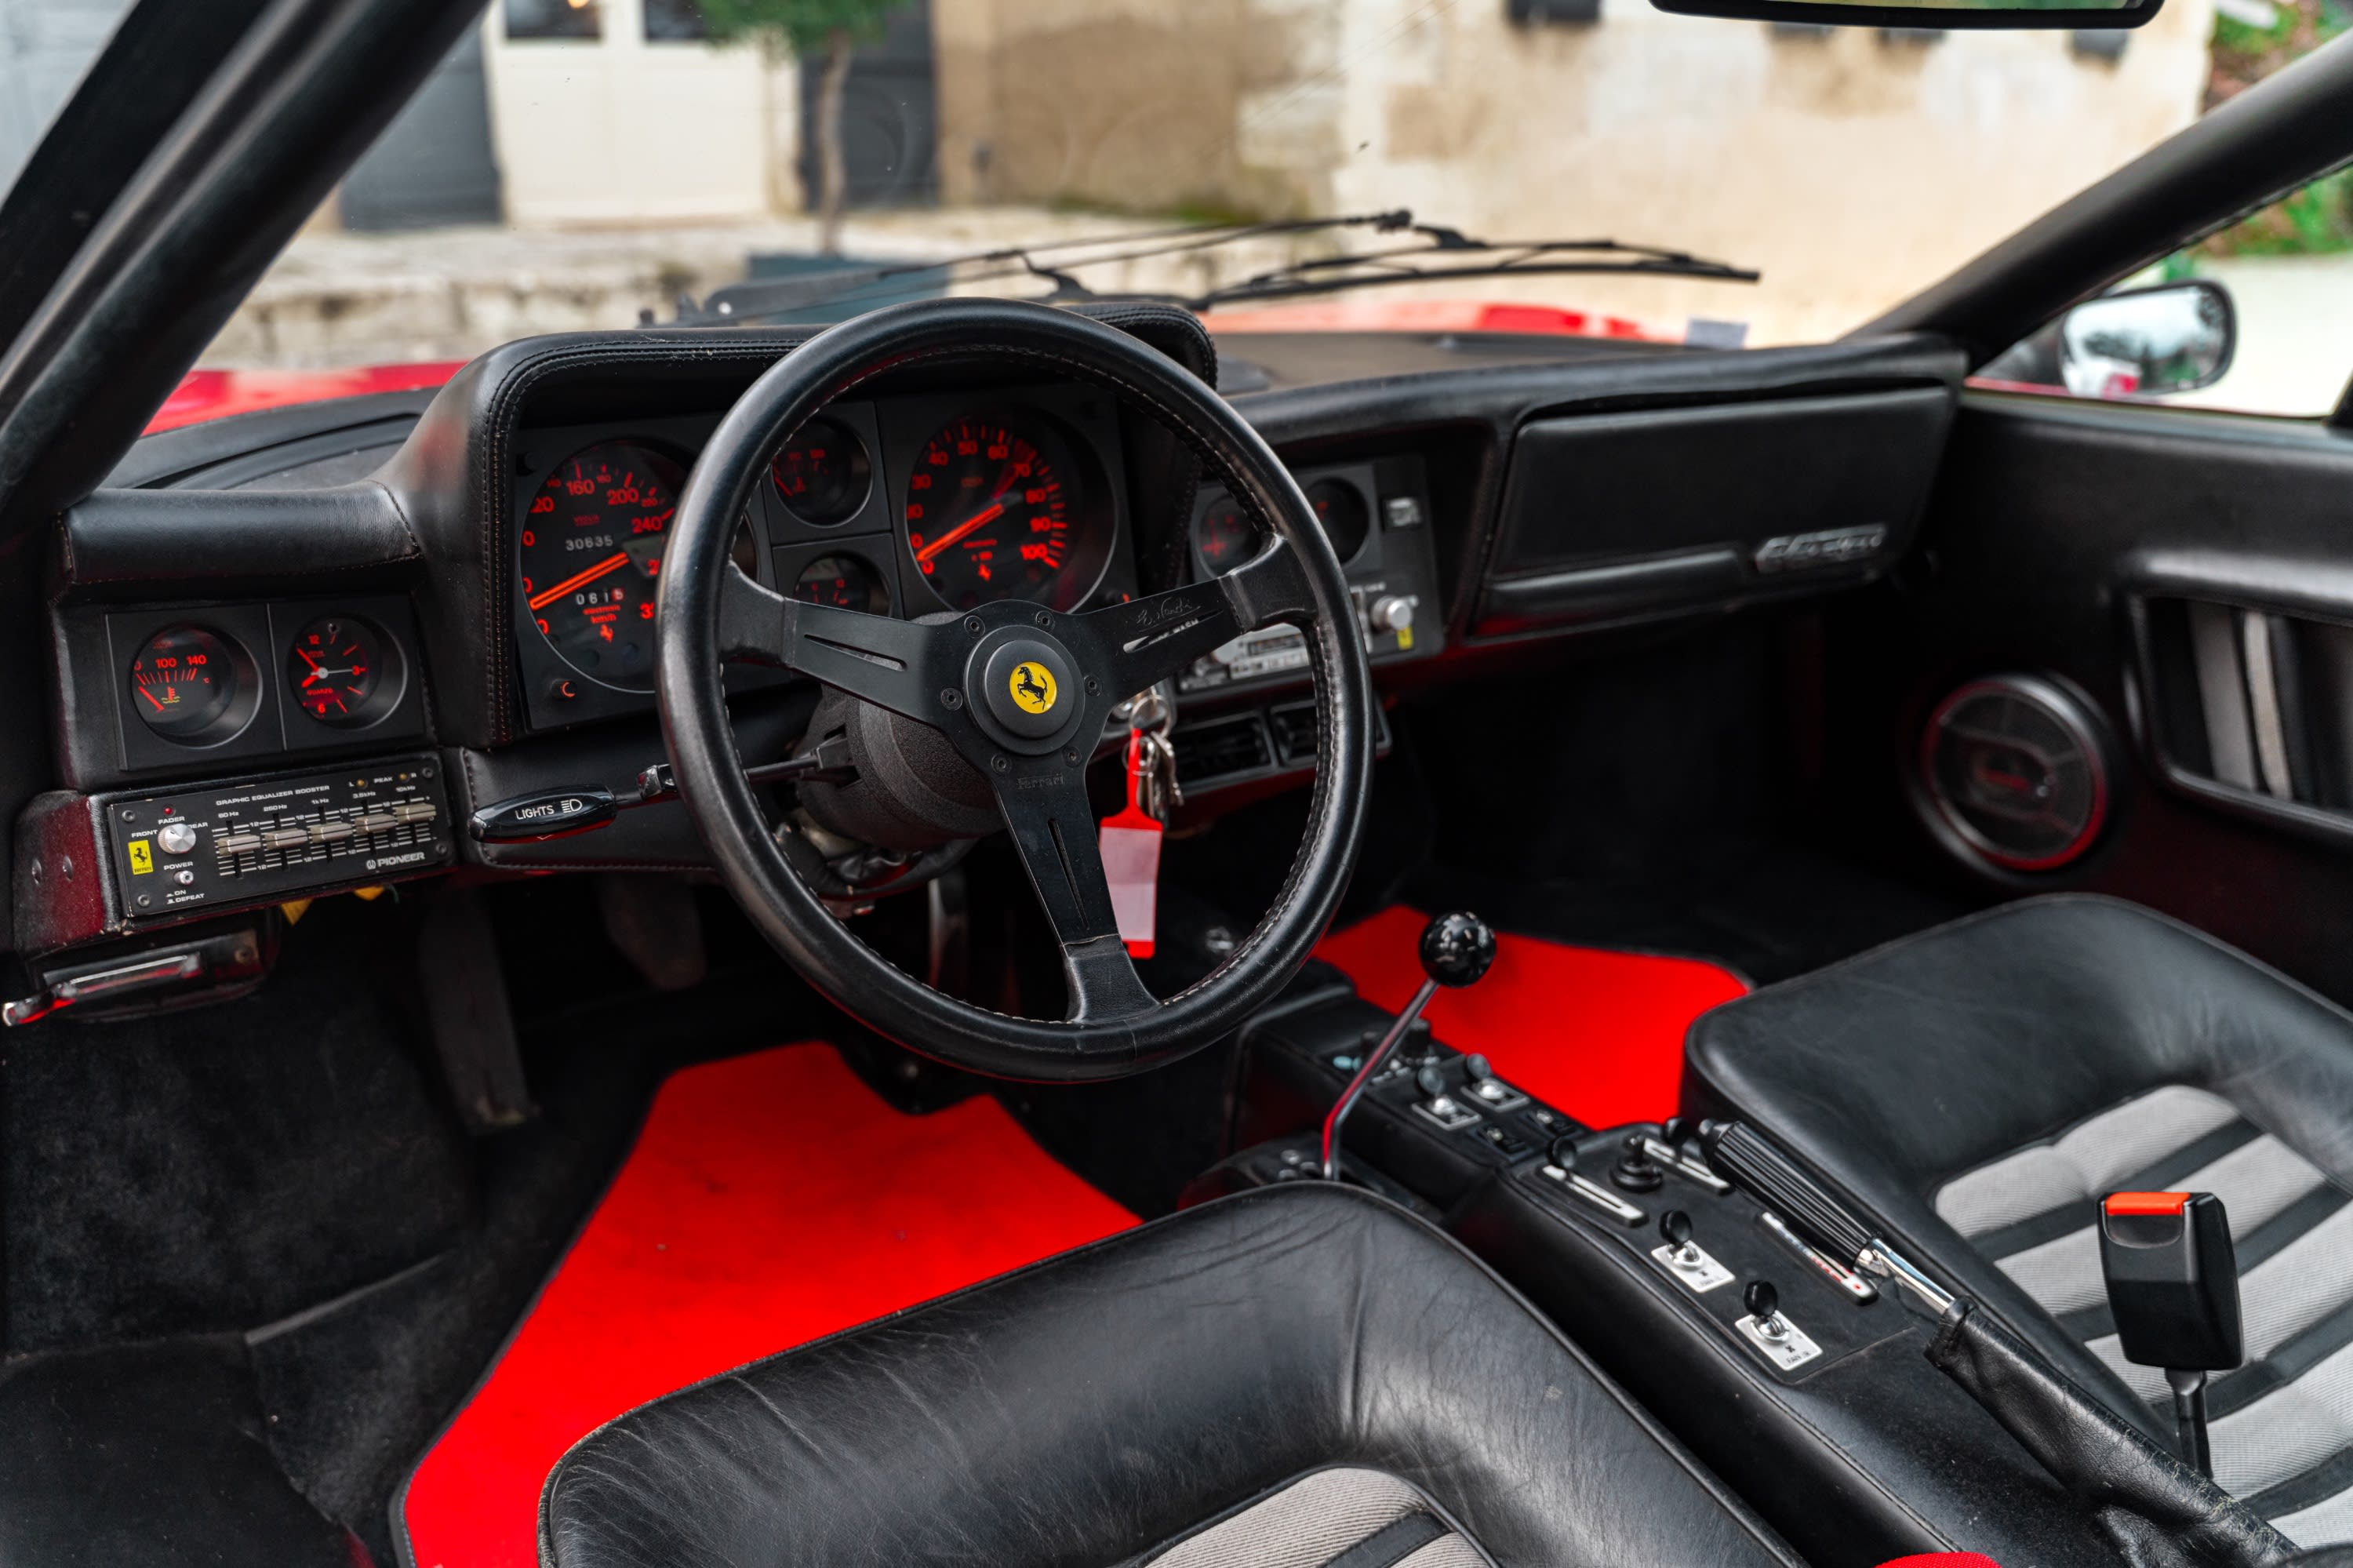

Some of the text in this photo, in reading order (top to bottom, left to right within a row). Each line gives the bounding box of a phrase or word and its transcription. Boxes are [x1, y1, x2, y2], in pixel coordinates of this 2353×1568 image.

[566, 479, 595, 496] 160
[606, 488, 639, 506] 200
[530, 496, 555, 514] 20
[631, 515, 663, 534] 240
[566, 535, 613, 551] 30635
[308, 634, 320, 645] 12
[156, 657, 177, 669] 100
[186, 654, 207, 666] 140
[317, 703, 326, 714] 6
[216, 785, 330, 806] GRAPHIC EQUALIZER BOOSTER
[515, 804, 555, 820] LIGHTS
[158, 816, 185, 824] FADER
[131, 829, 158, 838] FRONT
[164, 861, 193, 870] POWER
[377, 852, 425, 867] PIONEER
[175, 893, 205, 904] DEFEAT
